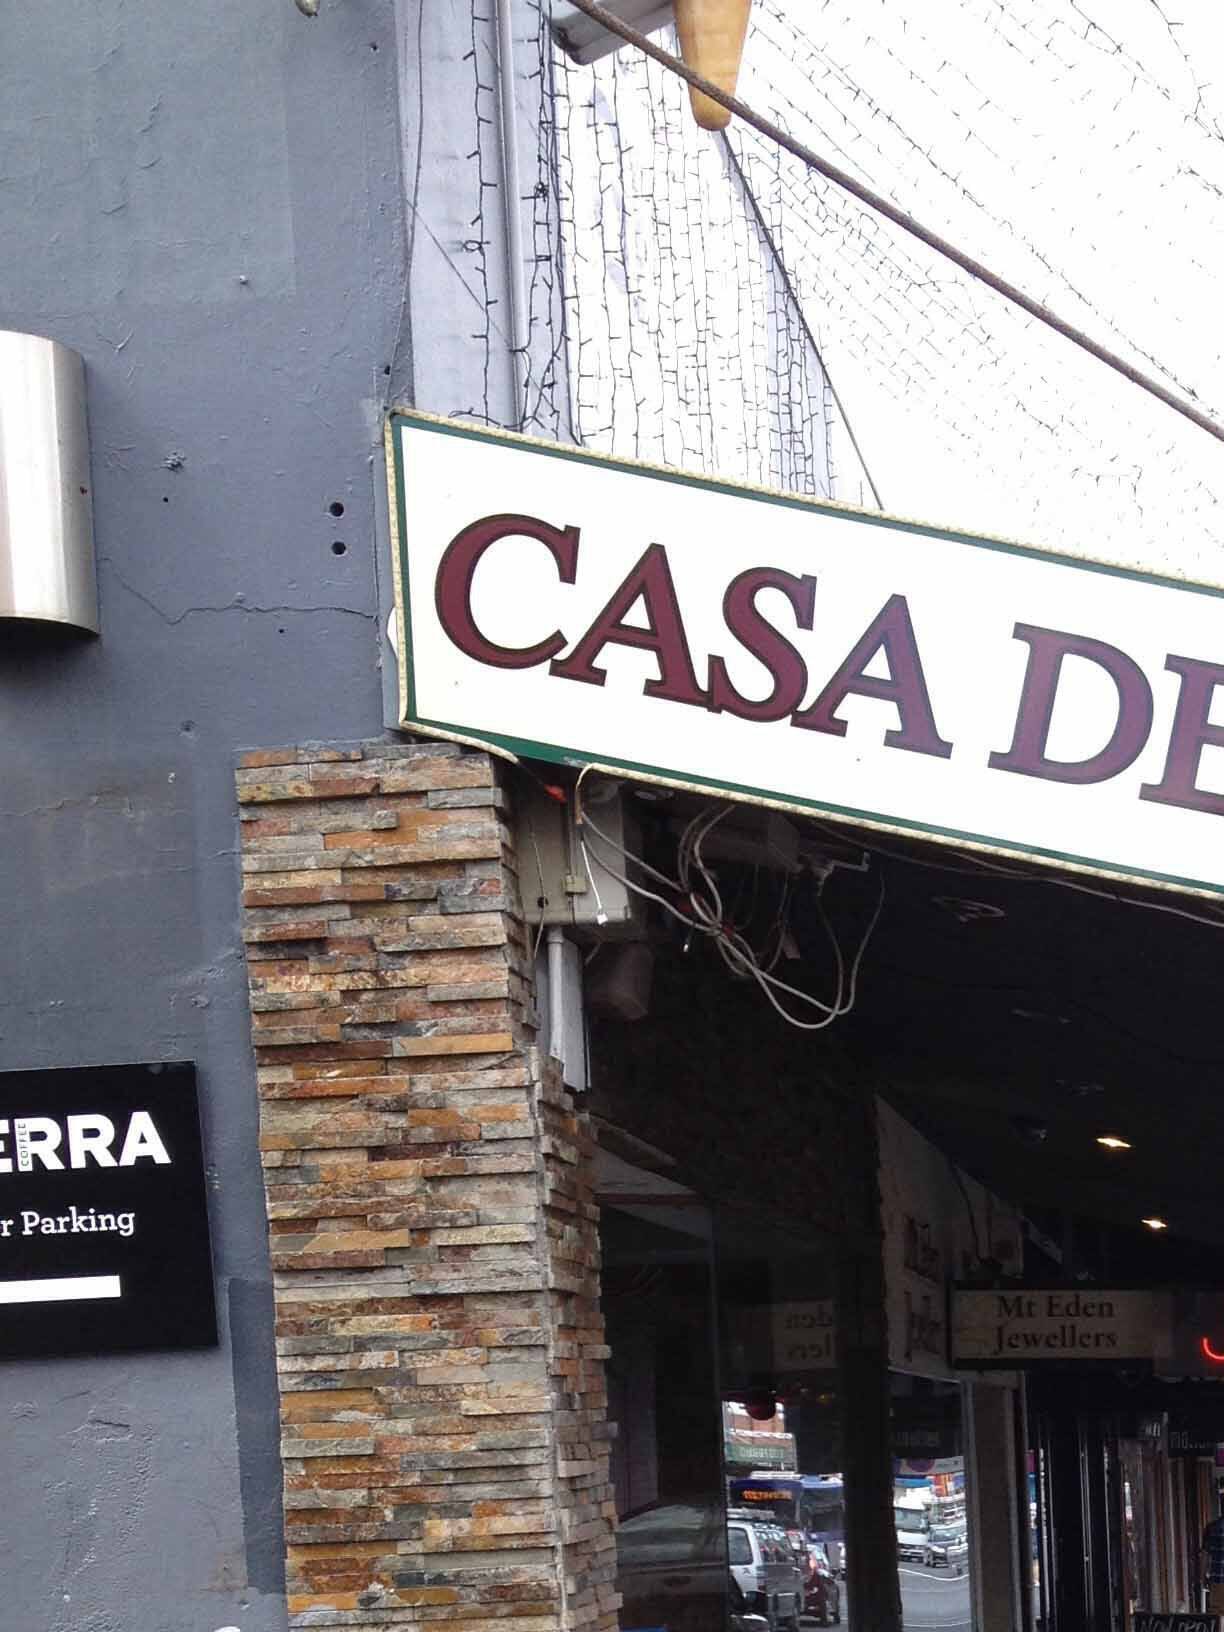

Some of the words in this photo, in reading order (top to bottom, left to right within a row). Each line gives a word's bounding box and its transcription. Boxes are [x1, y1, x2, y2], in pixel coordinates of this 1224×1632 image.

[435, 514, 953, 760] CASA
[0, 1111, 172, 1173] RRA
[21, 1206, 136, 1237] Parking
[997, 1294, 1034, 1319] Mt
[1046, 1293, 1115, 1319] Eden
[992, 1323, 1120, 1355] Jewellers
